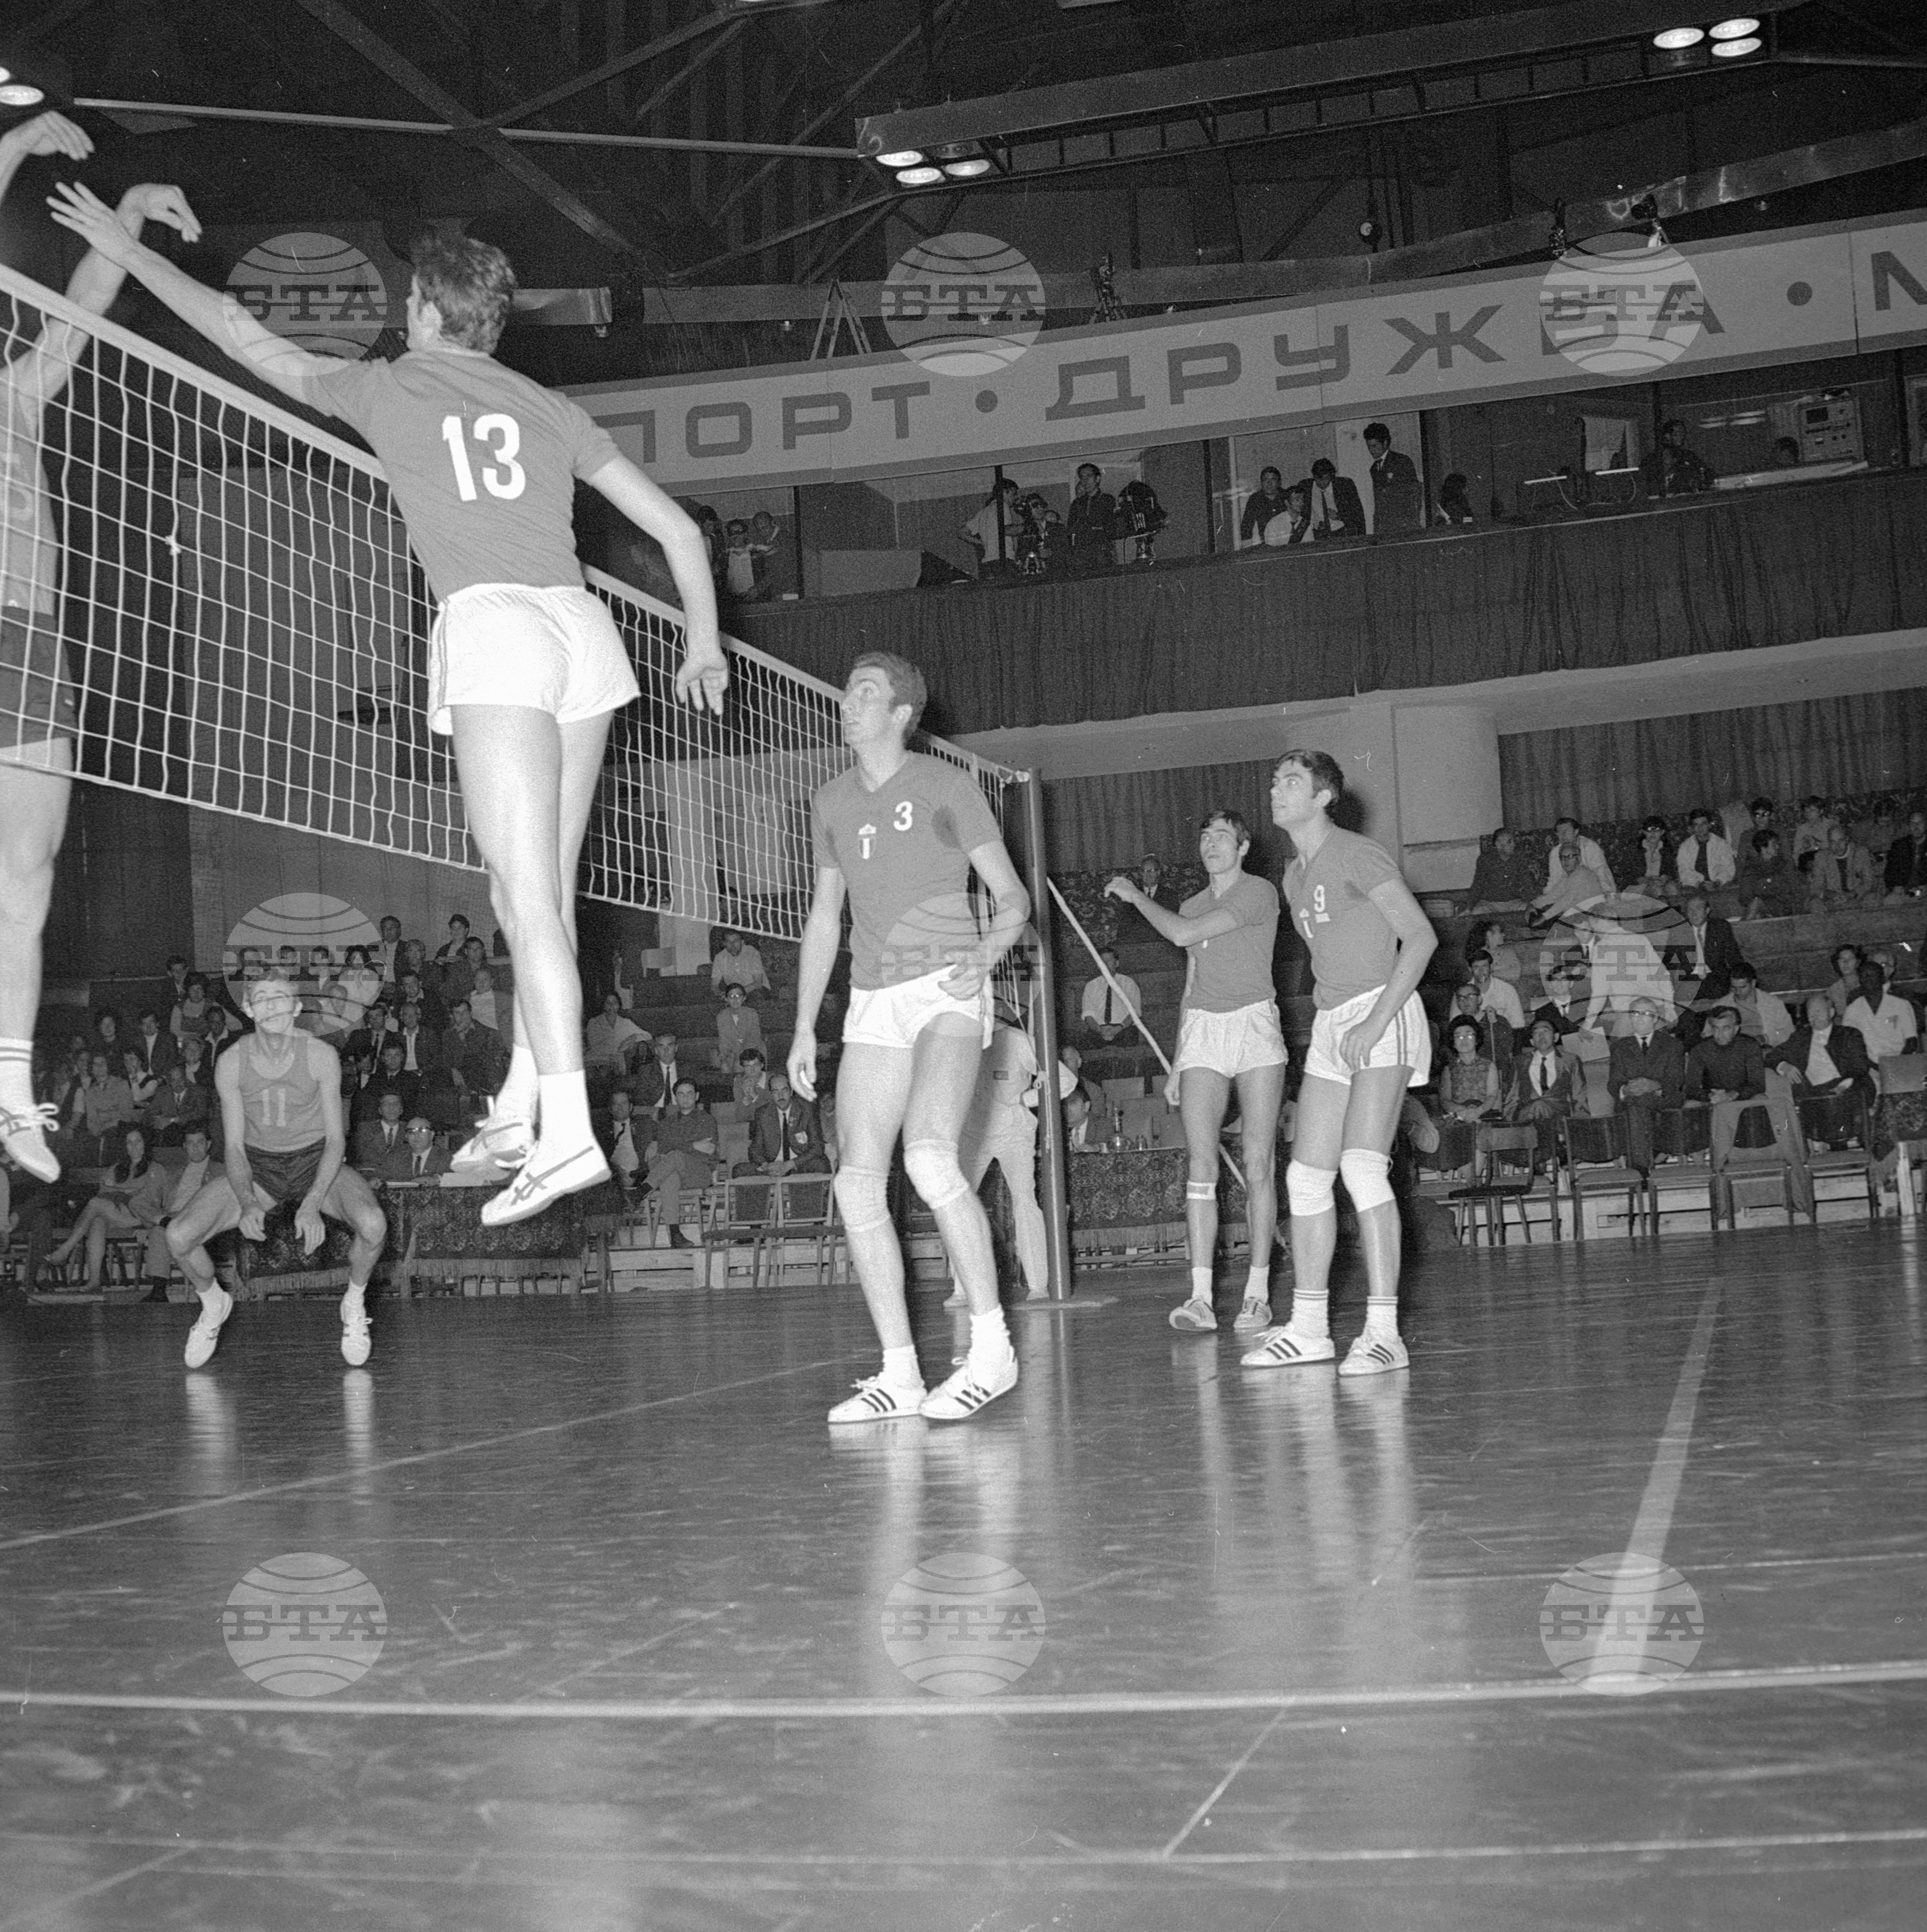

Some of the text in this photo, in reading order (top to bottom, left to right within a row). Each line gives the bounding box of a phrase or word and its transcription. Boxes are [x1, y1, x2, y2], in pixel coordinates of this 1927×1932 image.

[1045, 279, 1726, 421] ДРУЖБА
[442, 413, 526, 501] 13
[894, 801, 913, 831] 3
[1313, 884, 1325, 913] 9
[261, 1088, 286, 1127] 11
